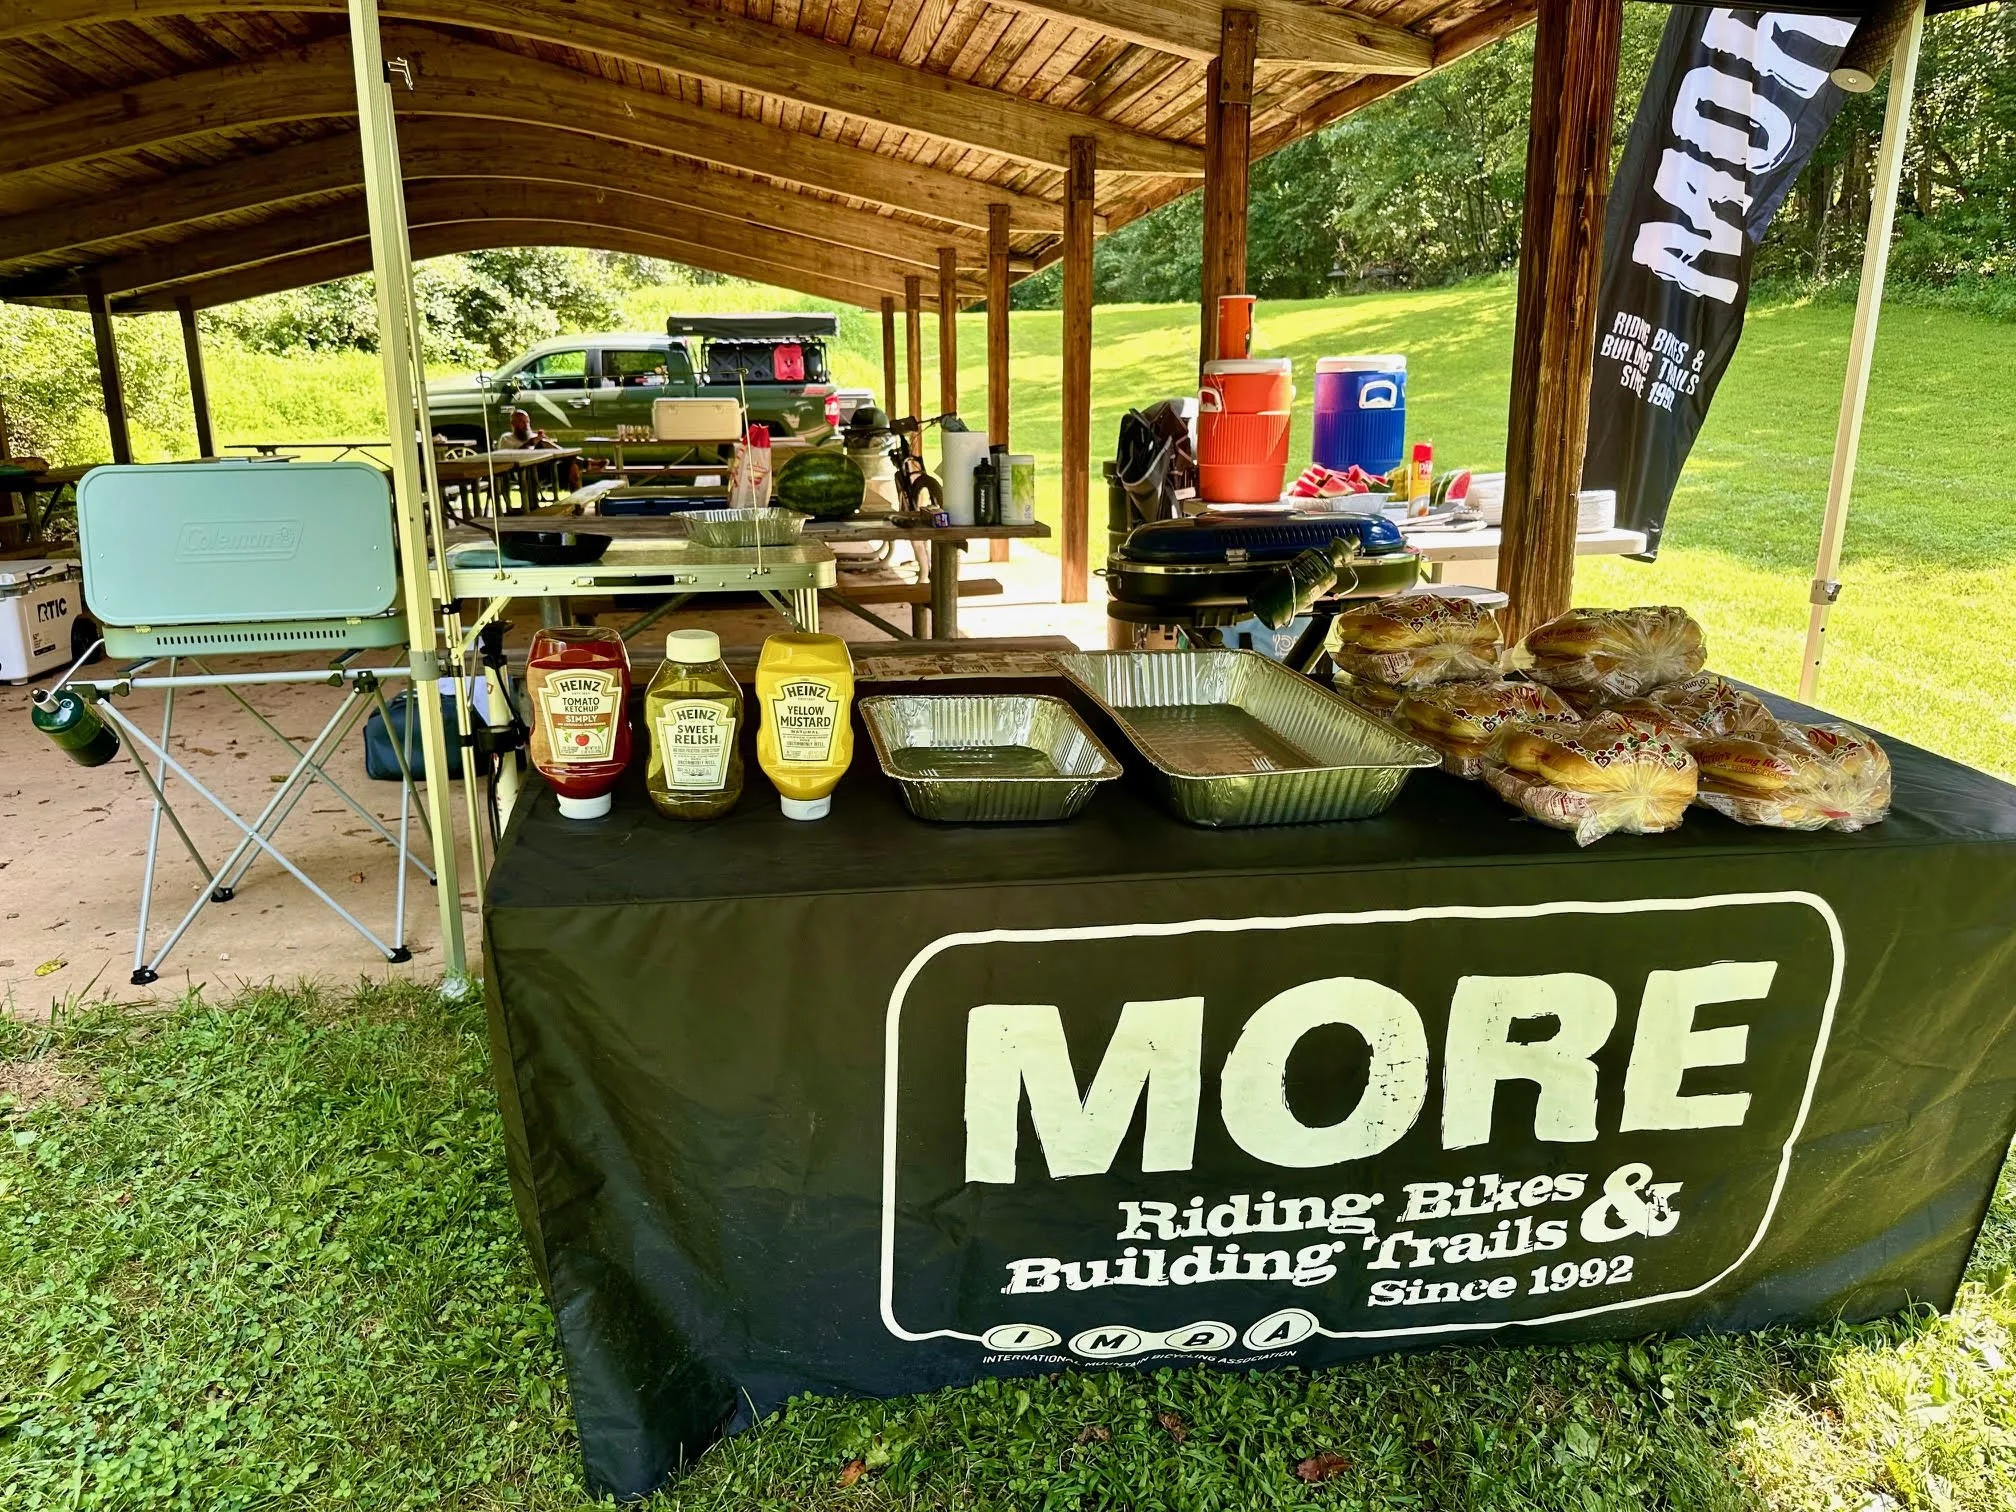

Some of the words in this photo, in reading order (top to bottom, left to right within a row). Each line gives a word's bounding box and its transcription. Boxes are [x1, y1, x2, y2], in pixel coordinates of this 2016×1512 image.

[1632, 8, 1858, 304] MOR
[1612, 311, 1651, 346] RIDNG
[1692, 349, 1705, 373] &
[1600, 334, 1653, 374] BUILDNG
[1620, 364, 1646, 398] SINE
[37, 597, 67, 623] RTIC
[559, 679, 601, 693] HEINZ
[786, 685, 826, 698] HEINZ
[563, 697, 600, 706] TOMATO
[564, 705, 599, 713] KETCHUP
[676, 708, 717, 721] HEINZ
[787, 705, 824, 716] YELLOW
[565, 715, 598, 723] SIMPLY
[780, 716, 831, 727] MUSTARD
[677, 725, 715, 734] SWEET
[674, 734, 718, 745] RELISH
[964, 961, 1778, 1185] MORE
[1117, 1191, 1384, 1251] Riding
[1396, 1173, 1588, 1222] Bikes
[1580, 1163, 1683, 1243] &
[1001, 1241, 1346, 1295] Building
[1367, 1215, 1568, 1270] Trails
[1367, 1270, 1517, 1307] Since
[1528, 1255, 1634, 1296] 1992
[983, 1354, 1082, 1365] INTERNATIONAL
[1085, 1357, 1149, 1368] MOUNTAIN
[1151, 1353, 1216, 1362] BICYCLING
[1218, 1351, 1297, 1364] ASSOCIATION
